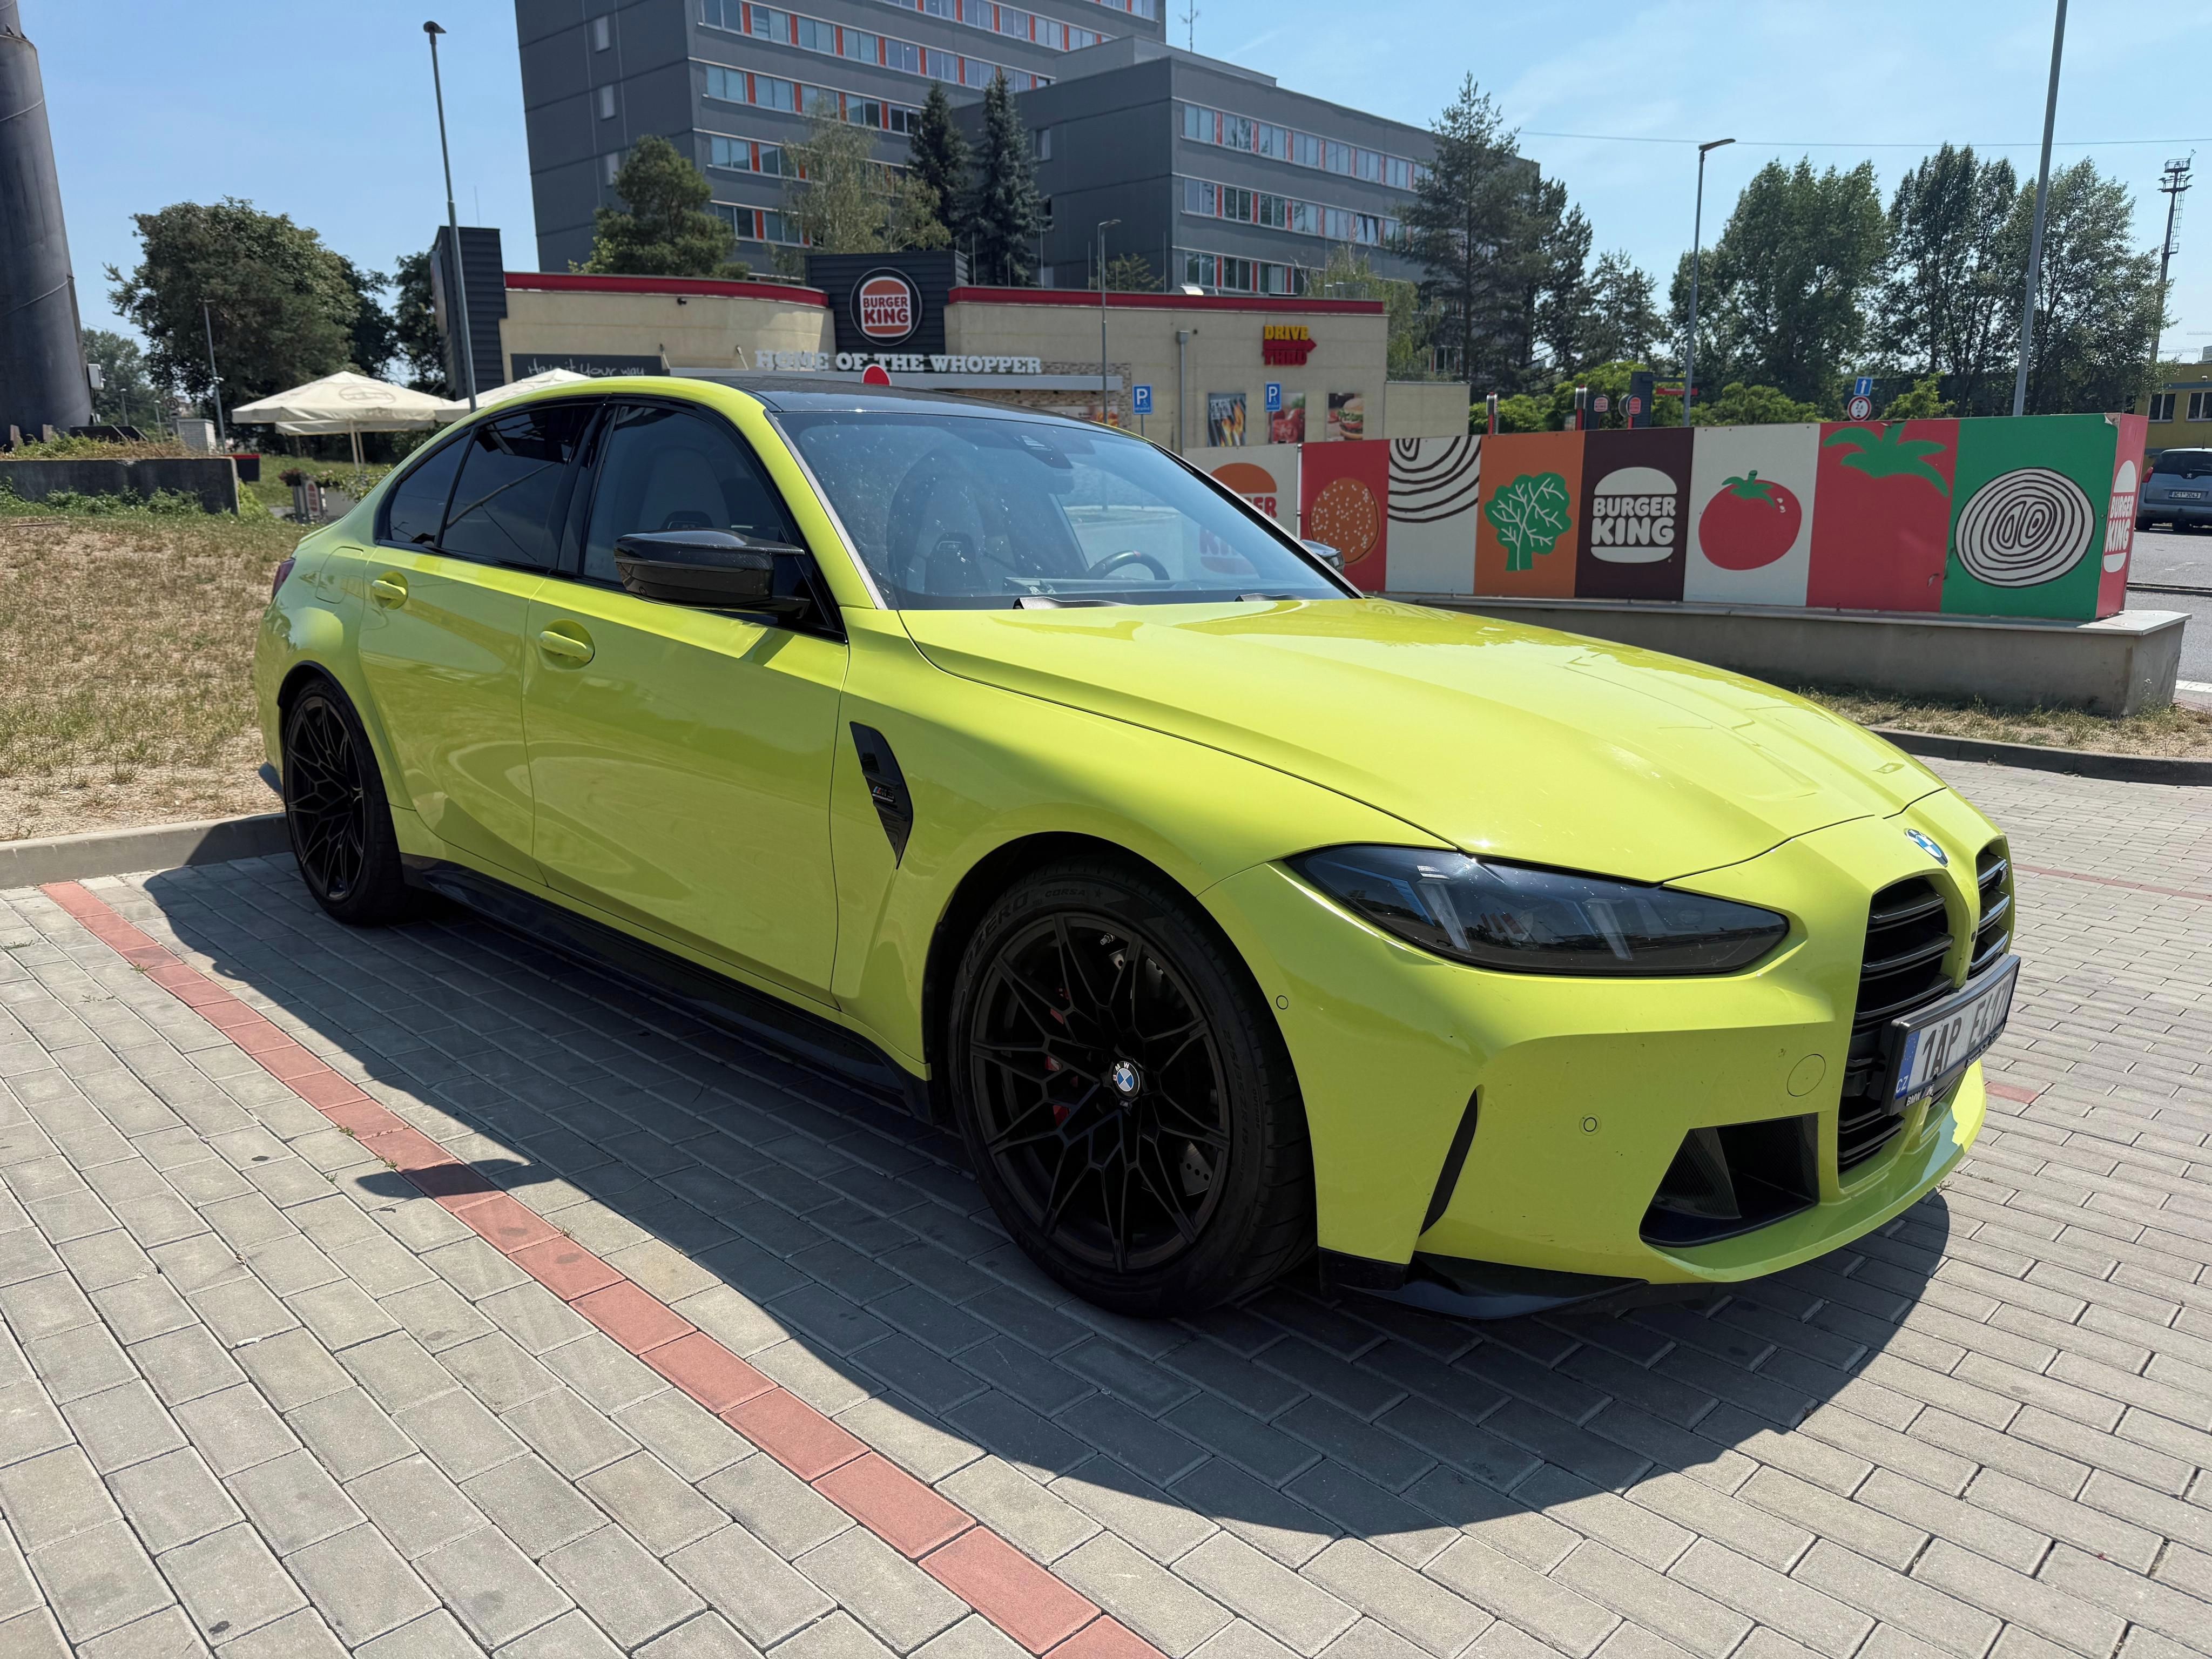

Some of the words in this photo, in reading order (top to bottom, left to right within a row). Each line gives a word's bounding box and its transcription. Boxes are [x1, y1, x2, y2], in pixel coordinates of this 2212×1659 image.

[863, 297, 908, 308] BURGER
[864, 308, 908, 324] KING
[1264, 325, 1309, 340] DRIVE
[755, 350, 829, 371] HOME
[835, 352, 868, 371] OF
[866, 353, 924, 372] THE
[929, 354, 1042, 373] WHOPPER
[1262, 350, 1307, 366] THRU
[1136, 388, 1148, 406] P
[1268, 386, 1278, 403] P
[1593, 497, 1676, 517] BURGER
[2109, 495, 2134, 519] BURGER
[1591, 517, 1675, 545] KING
[2105, 518, 2131, 552] KING
[1045, 888, 1085, 898] CORSA
[1922, 1017, 1962, 1082] 1AP
[1112, 1062, 1130, 1081] BMW
[1896, 1075, 1909, 1094] CZ
[1906, 1089, 1922, 1107] BMW
